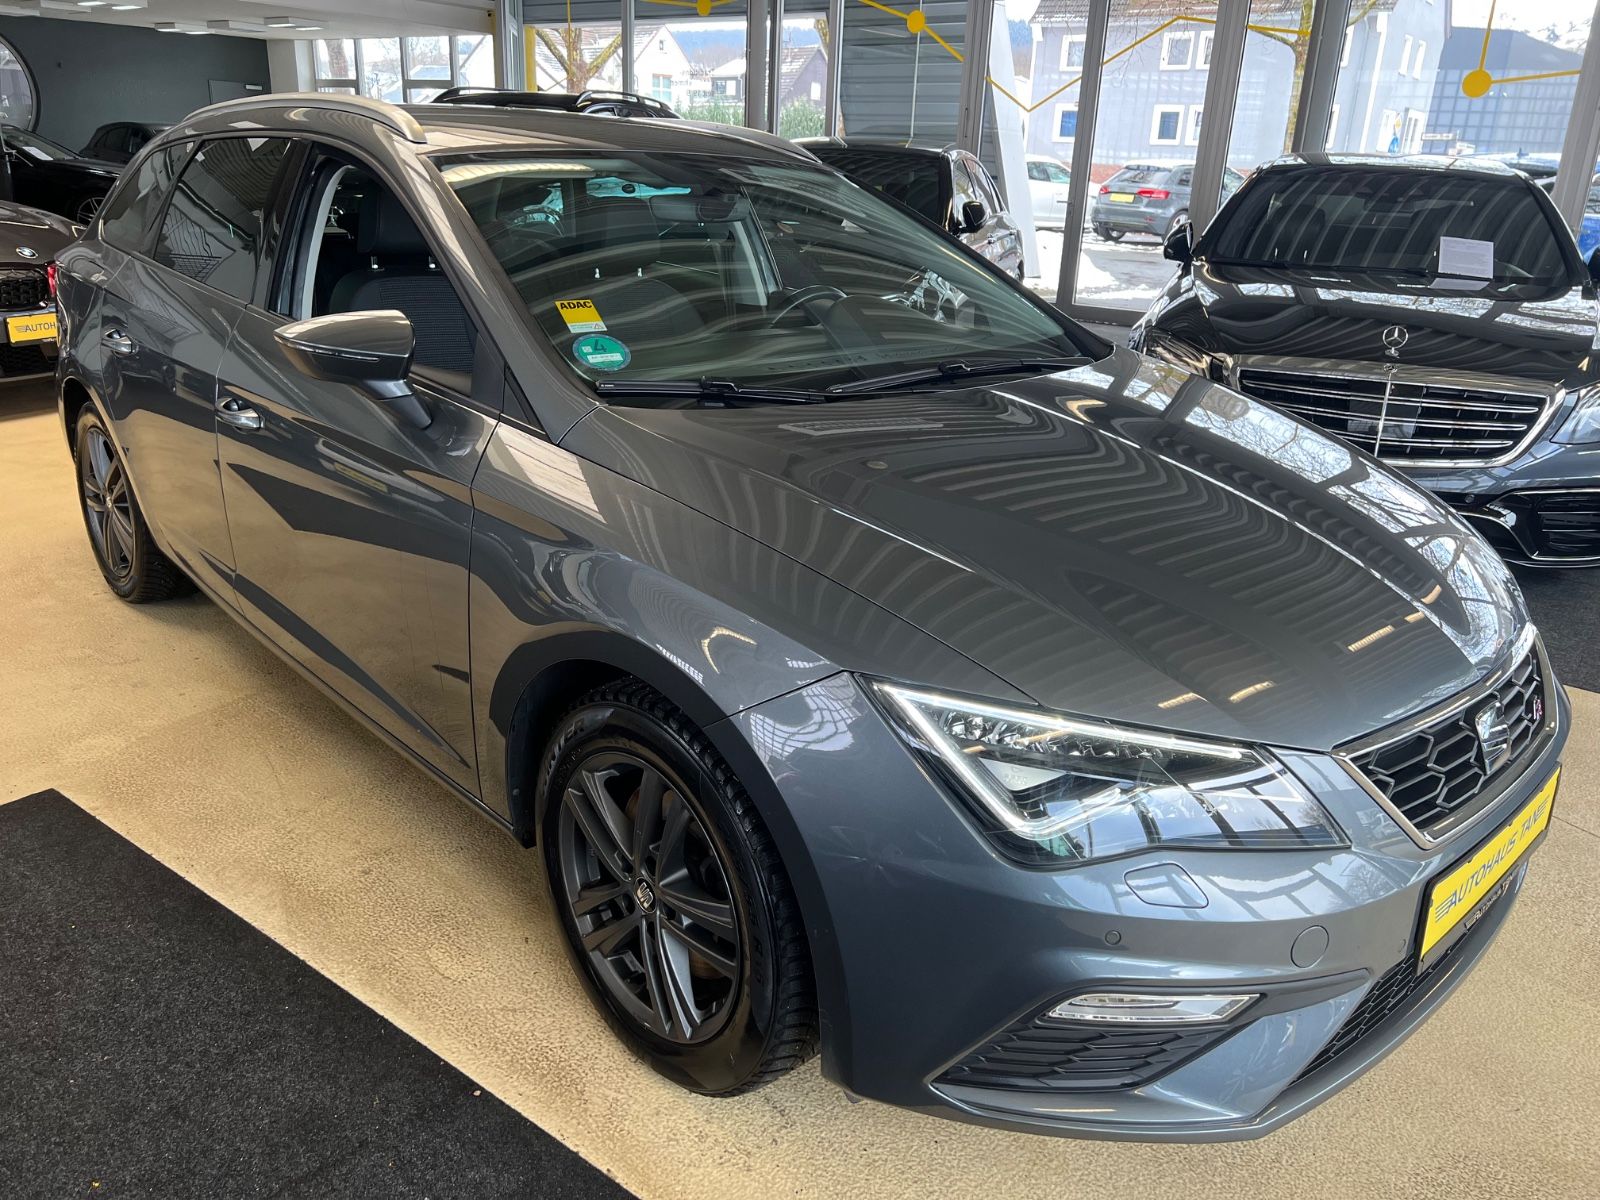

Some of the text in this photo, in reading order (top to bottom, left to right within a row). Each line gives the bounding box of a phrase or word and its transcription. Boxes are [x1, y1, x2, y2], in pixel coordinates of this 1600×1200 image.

[559, 301, 592, 310] ADAC
[25, 322, 56, 332] AUTOH
[594, 339, 607, 353] 4
[1448, 831, 1518, 908] AUTOHAUS
